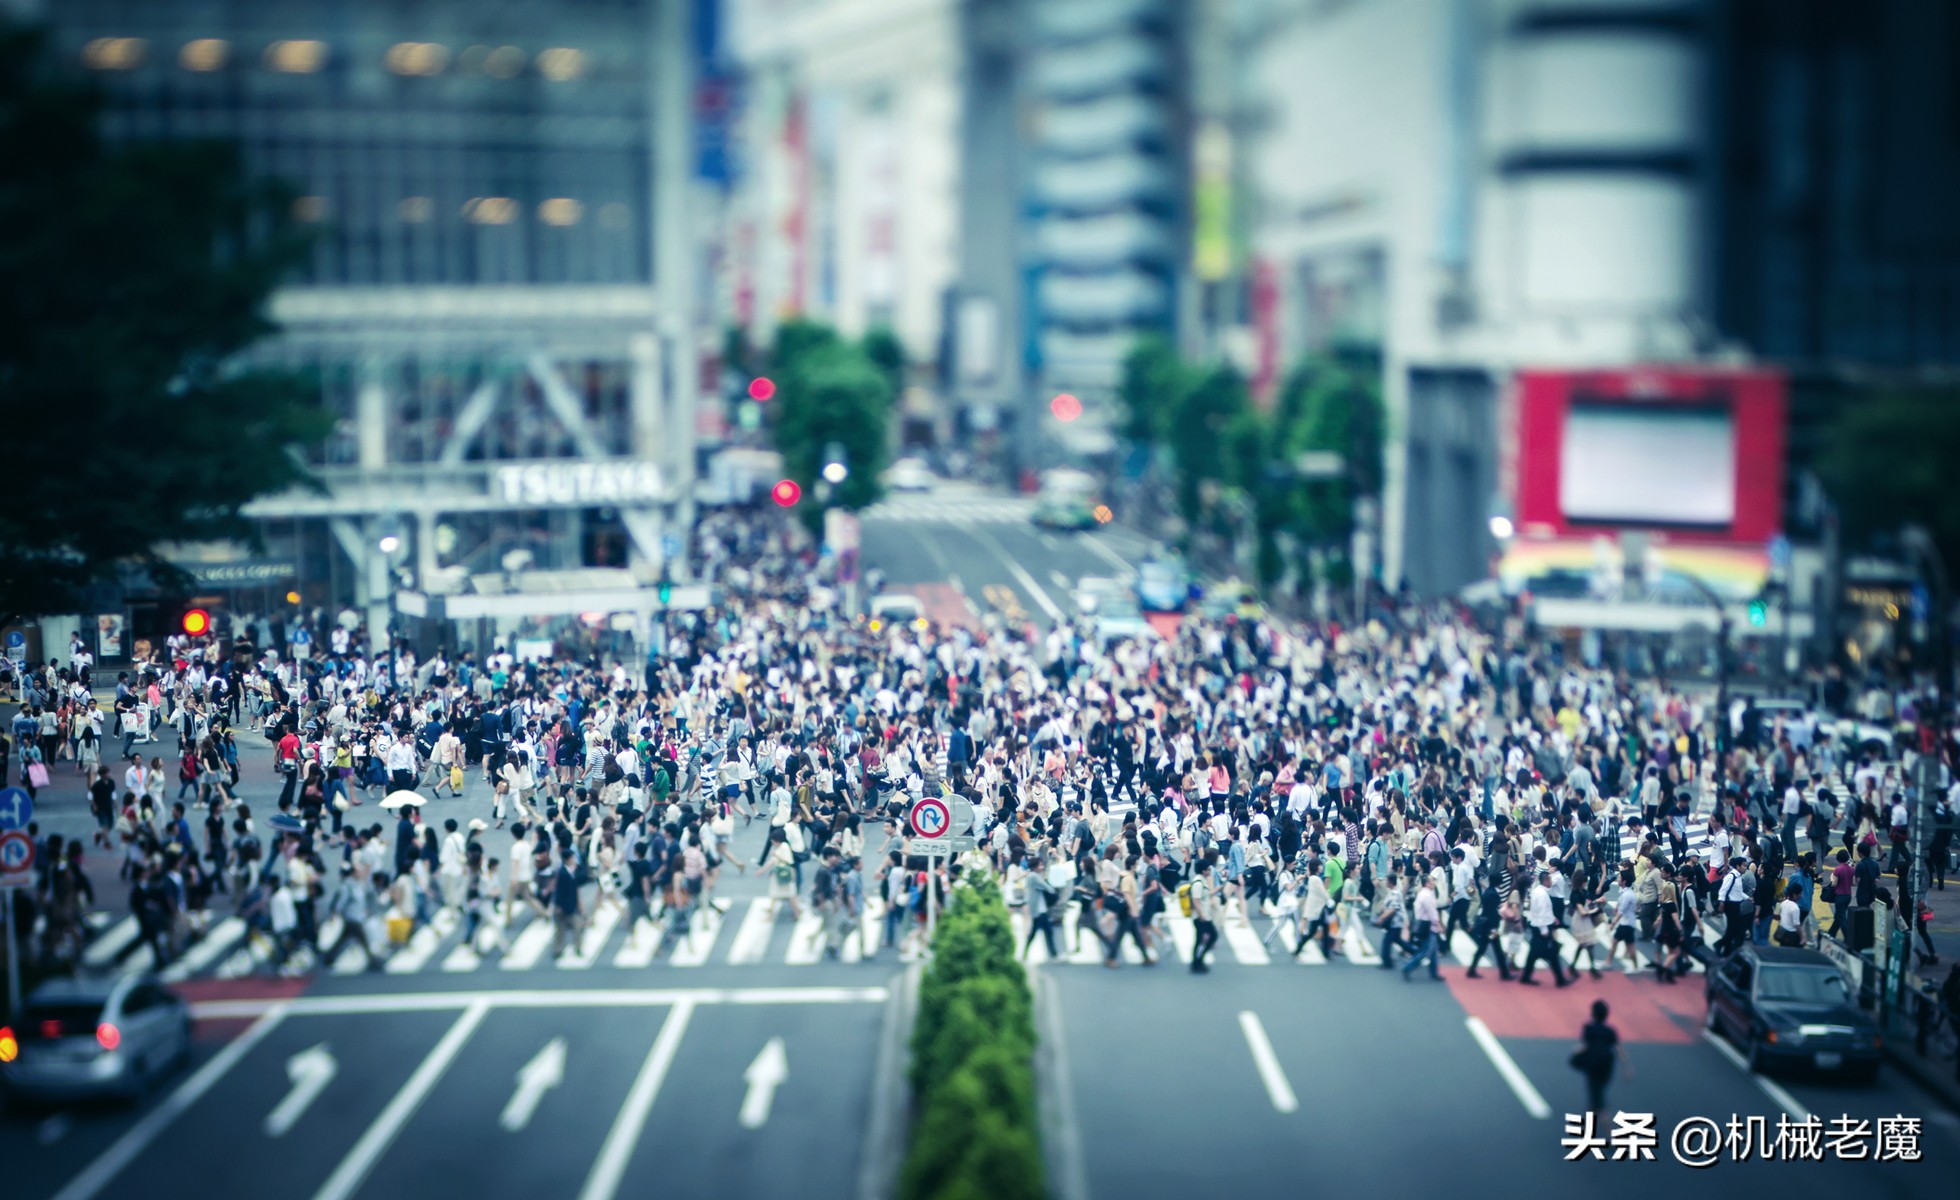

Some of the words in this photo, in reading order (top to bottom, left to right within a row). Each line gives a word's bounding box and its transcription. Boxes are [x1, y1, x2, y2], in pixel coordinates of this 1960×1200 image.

[499, 461, 663, 503] TSUTAYA
[913, 843, 947, 853] ここから
